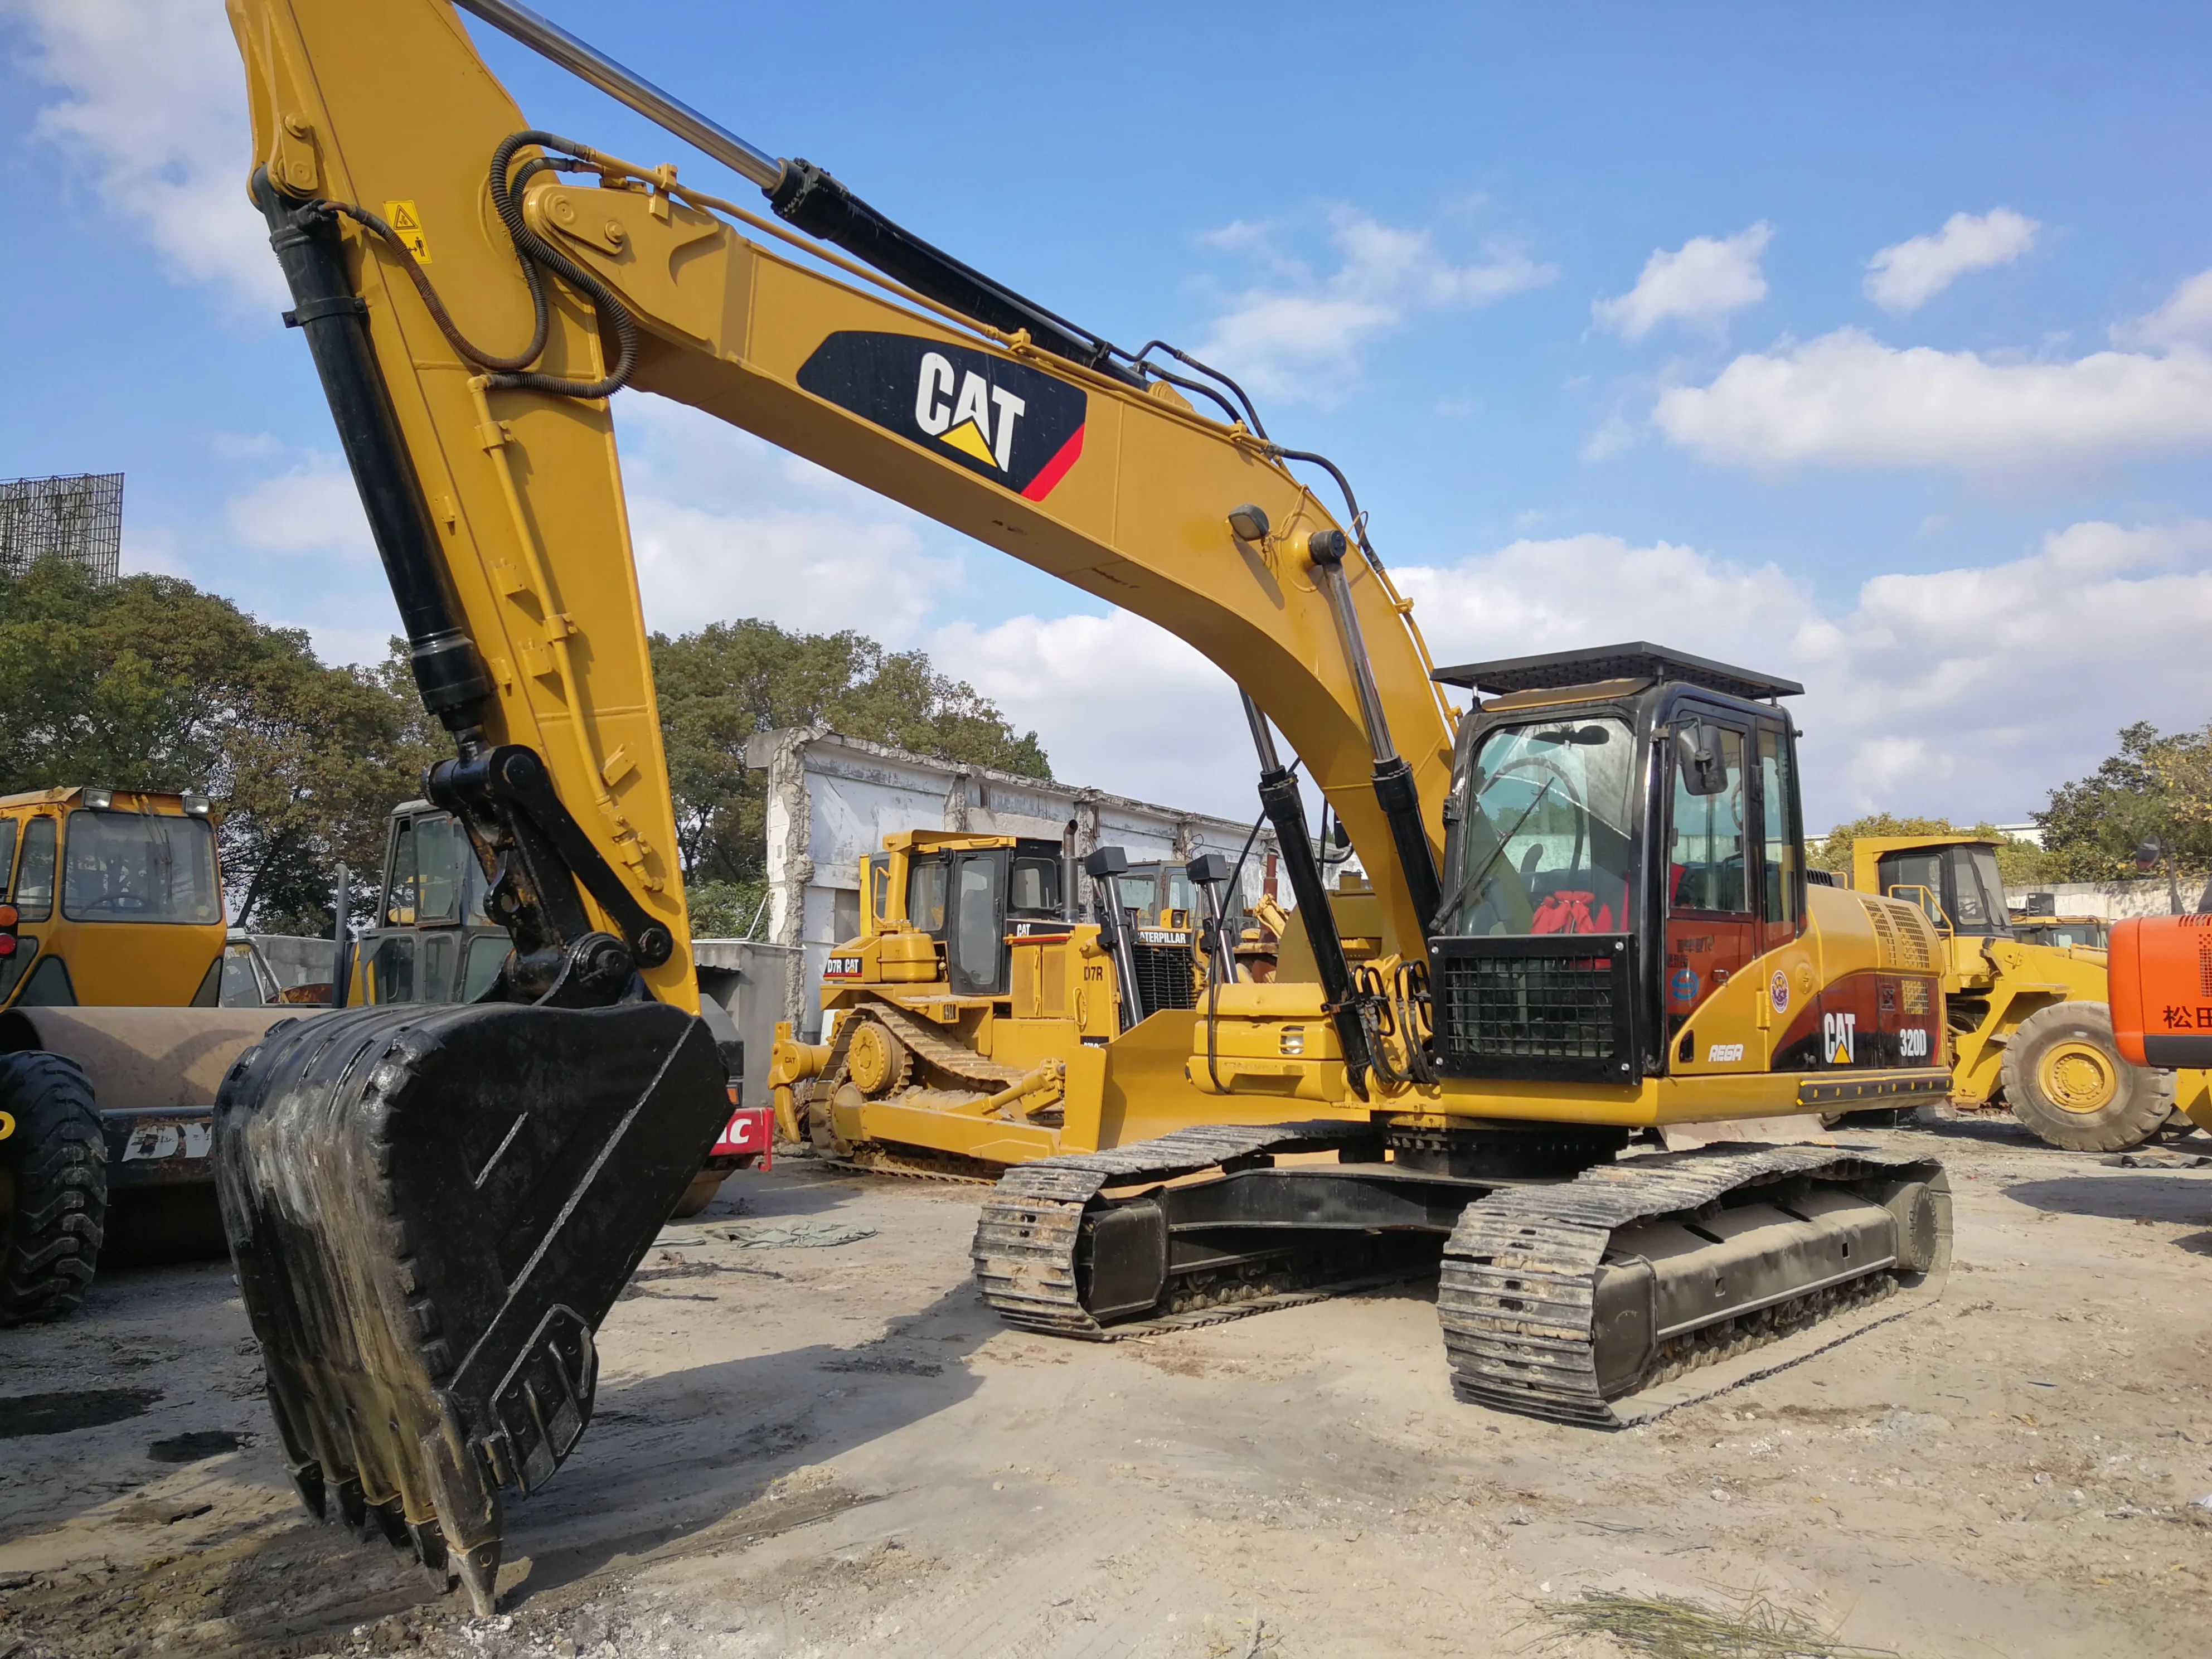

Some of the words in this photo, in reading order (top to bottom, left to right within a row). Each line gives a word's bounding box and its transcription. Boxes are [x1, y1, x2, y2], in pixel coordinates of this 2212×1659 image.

[915, 352, 1025, 473] CAT
[1017, 924, 1031, 937] CAT
[827, 959, 842, 973] D7R
[845, 959, 859, 973] CAT
[1084, 966, 1103, 981] D7R
[1824, 1013, 1855, 1063] CAT
[1900, 1029, 1927, 1056] 320D
